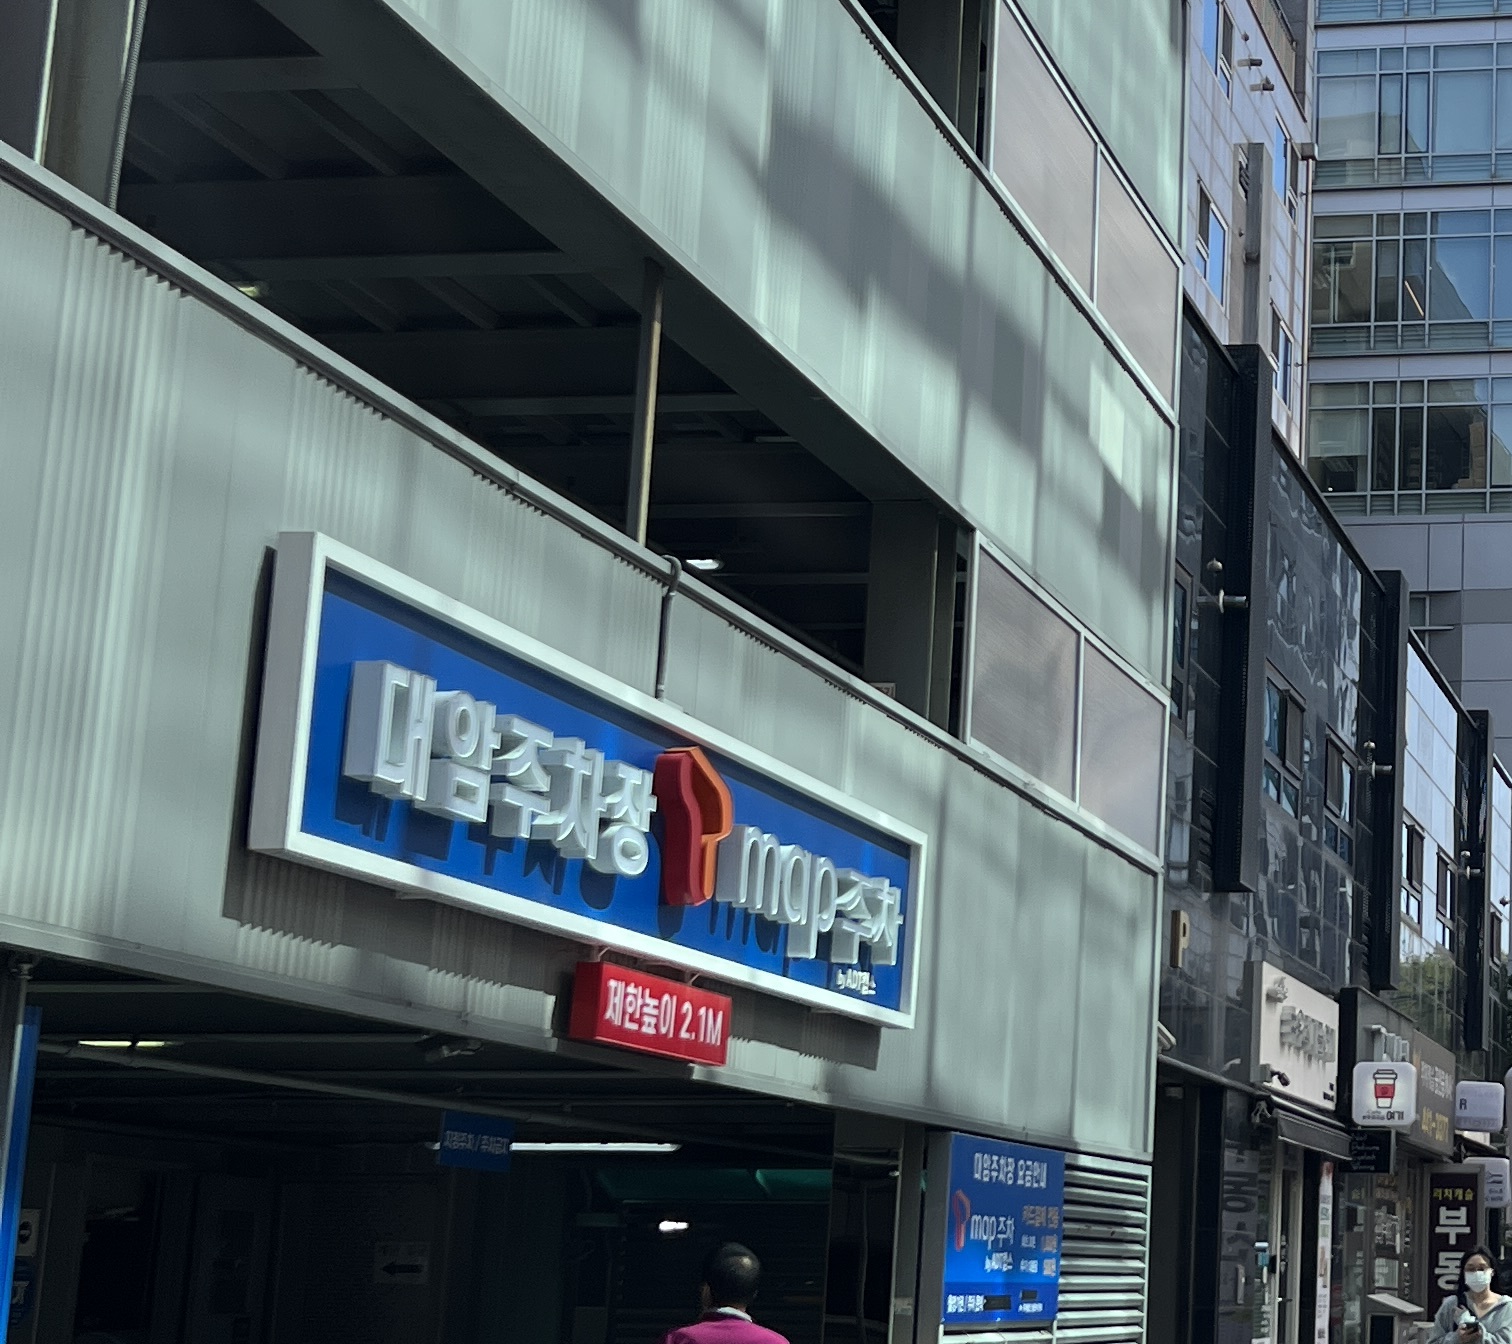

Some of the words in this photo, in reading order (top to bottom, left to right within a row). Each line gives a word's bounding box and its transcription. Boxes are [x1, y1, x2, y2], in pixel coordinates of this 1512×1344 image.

[345, 659, 657, 877] 대암주차장
[604, 977, 677, 1038] 제한높이
[679, 999, 724, 1048] 2.1M
[973, 1152, 1015, 1185] 대암주차장
[1017, 1159, 1048, 1189] 요금안내
[1433, 1188, 1474, 1201] 리치캐슬
[970, 1214, 1015, 1250] map주차
